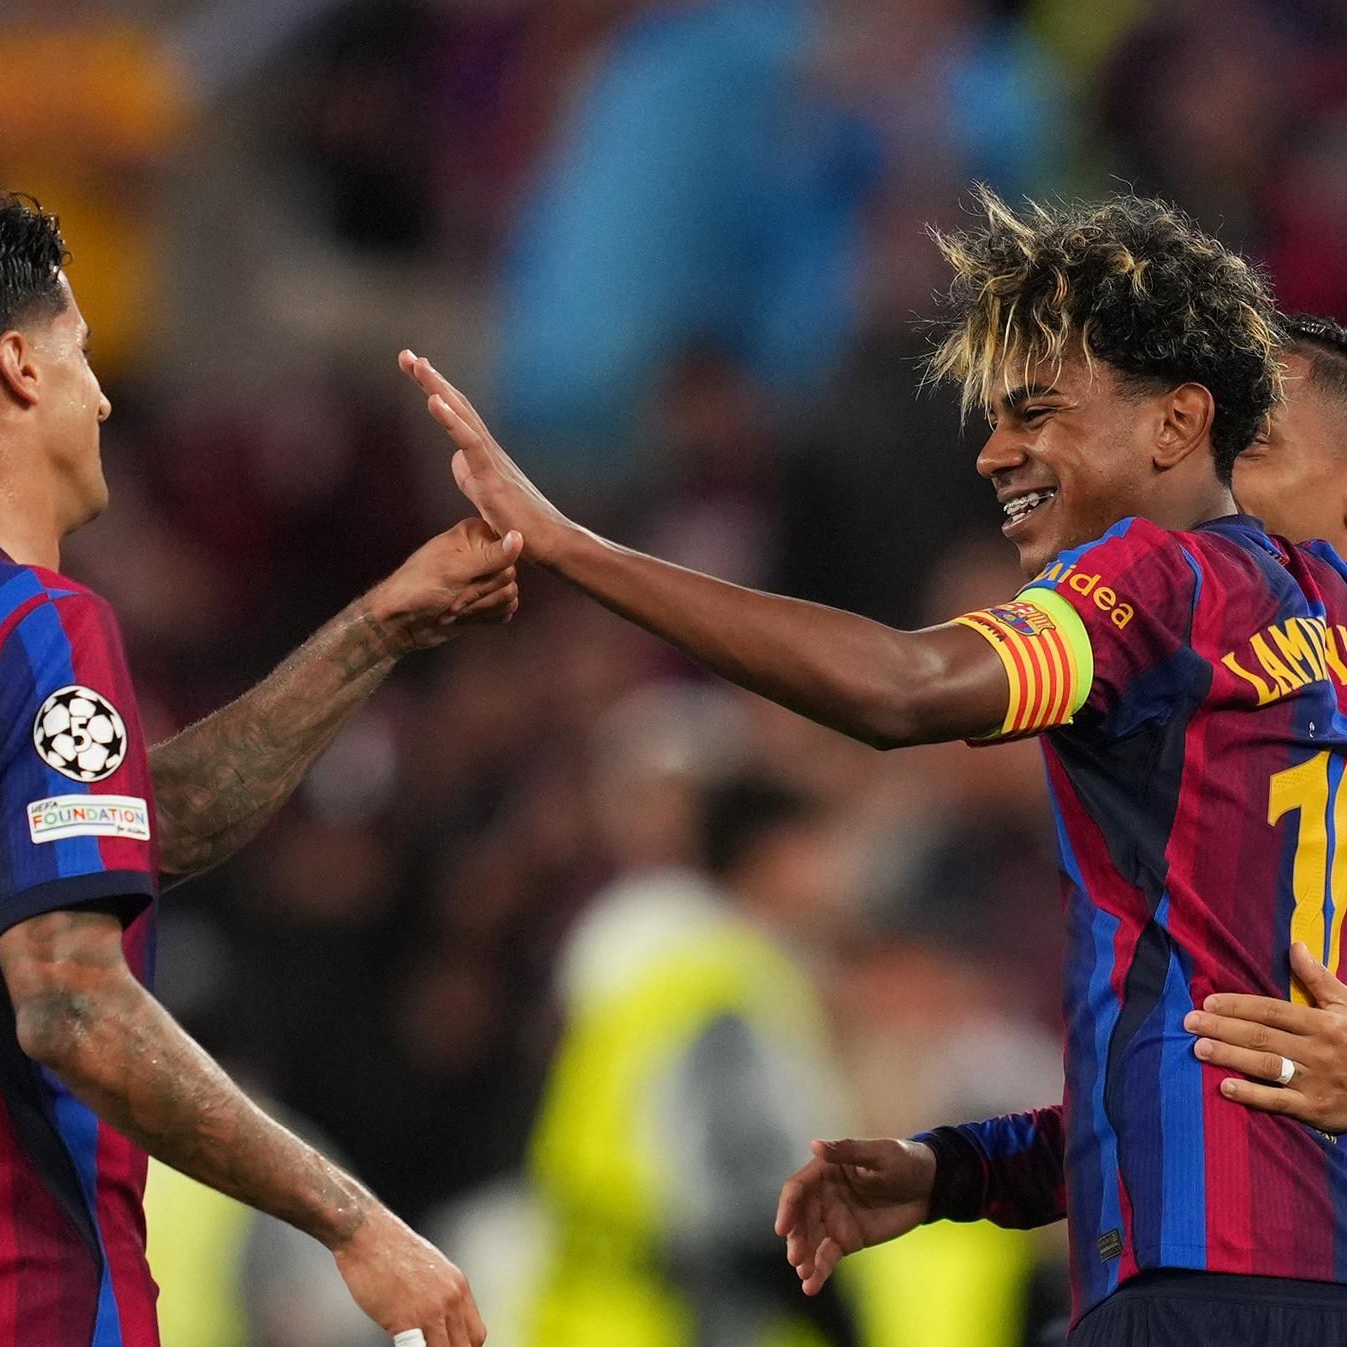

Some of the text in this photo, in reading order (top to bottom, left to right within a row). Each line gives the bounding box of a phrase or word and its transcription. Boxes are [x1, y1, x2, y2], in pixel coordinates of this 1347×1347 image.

[1035, 560, 1135, 630] Midea
[70, 716, 92, 753] 5
[33, 808, 145, 828] FOUNDATION
